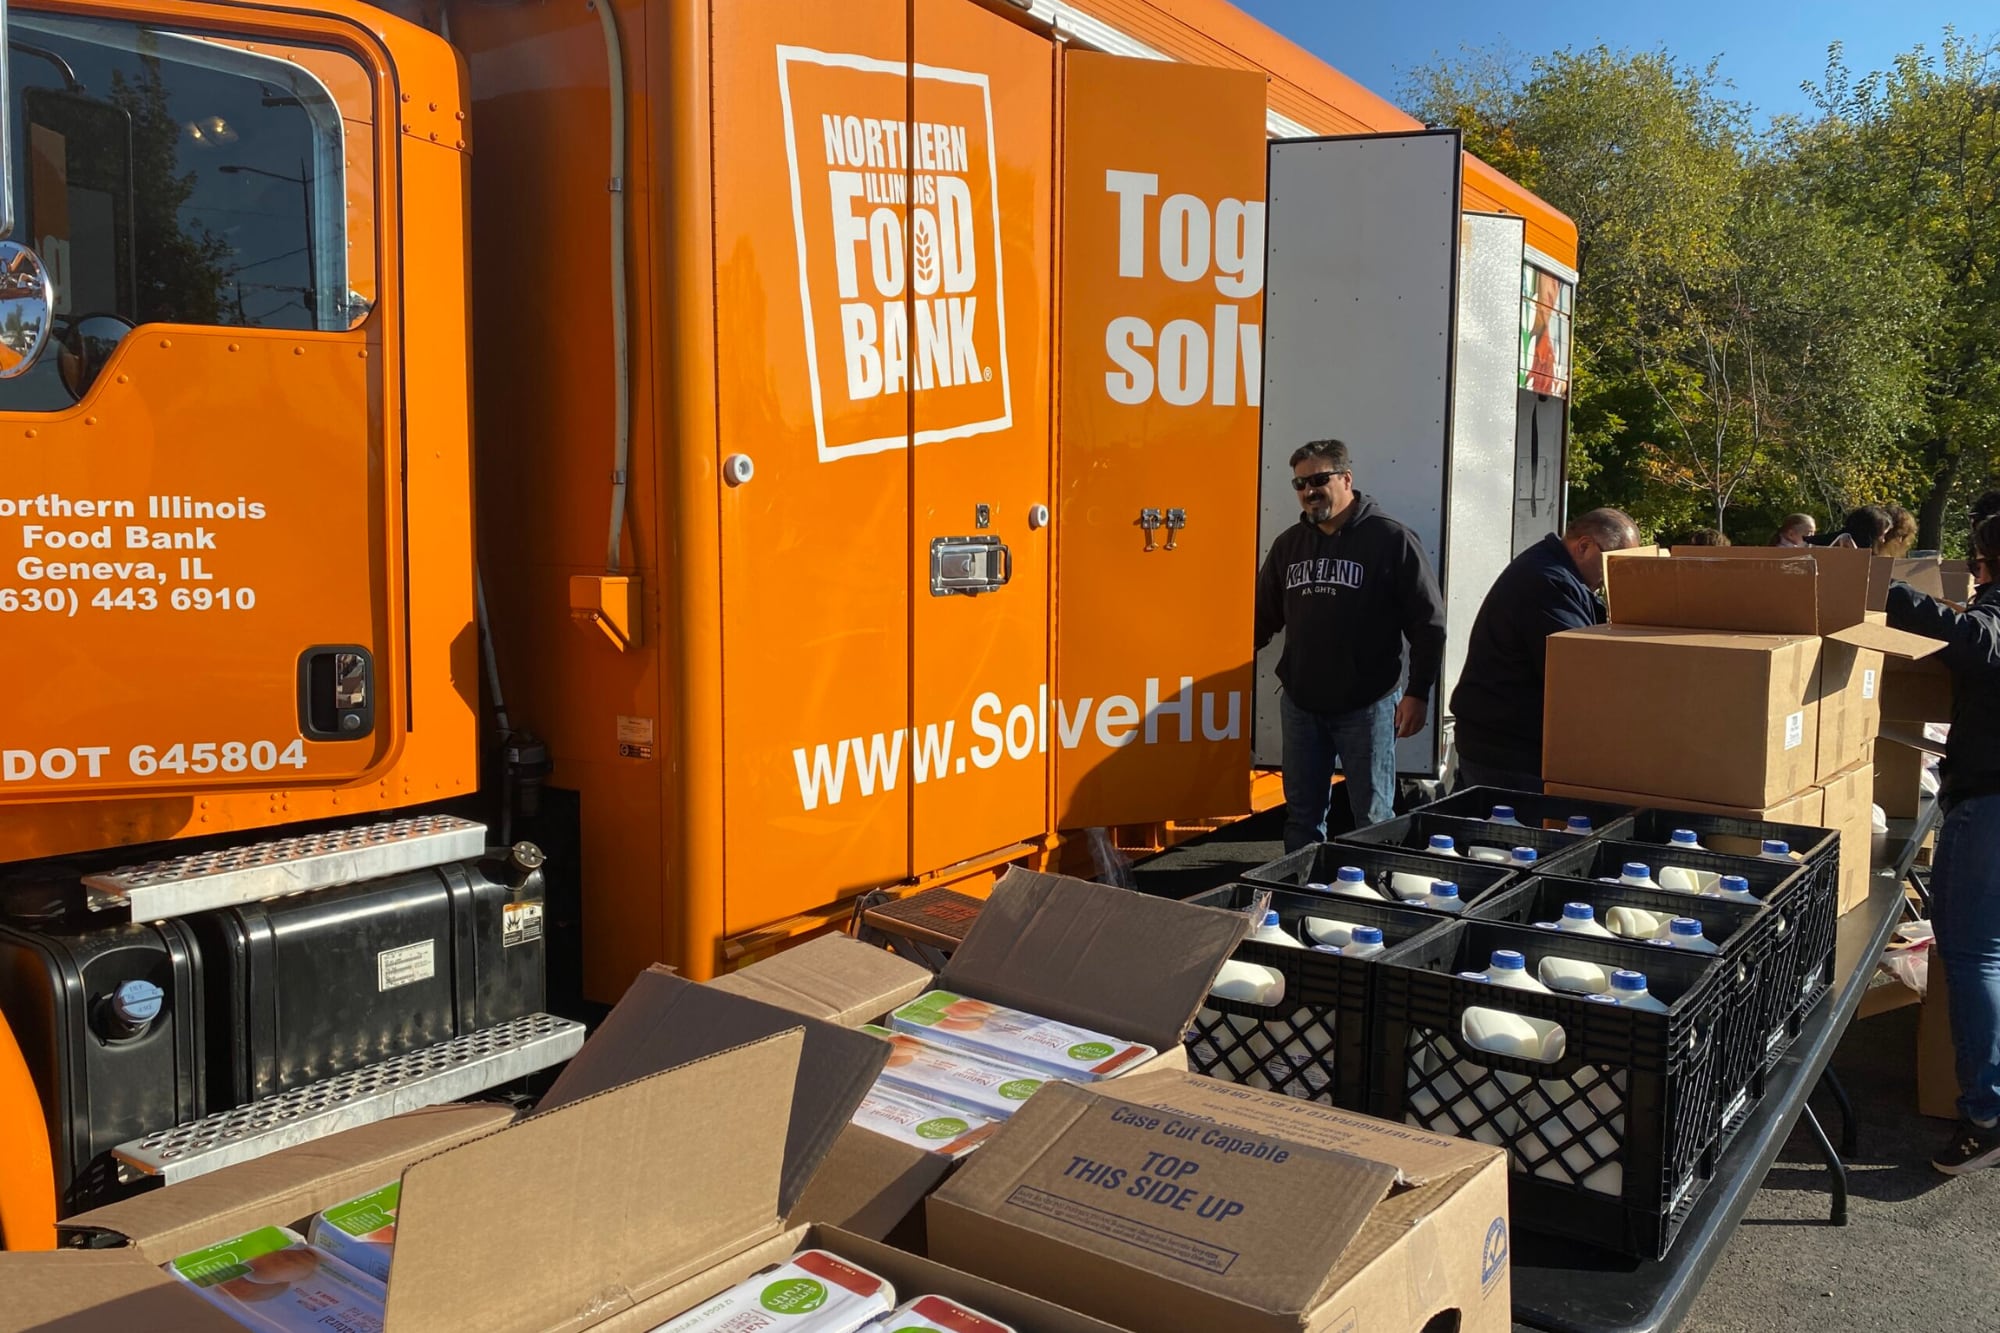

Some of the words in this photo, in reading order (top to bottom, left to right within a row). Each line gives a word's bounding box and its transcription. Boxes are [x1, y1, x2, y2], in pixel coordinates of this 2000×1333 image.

[822, 114, 969, 173] NORTHERN
[865, 172, 936, 205] ILLINOIS
[828, 171, 977, 299] FOOD
[1106, 169, 1265, 299] Tog
[148, 495, 267, 520] Illinois
[23, 525, 112, 549] Food
[125, 526, 217, 550] Bank
[17, 556, 167, 586] Geneva,
[180, 557, 213, 580] IL
[91, 587, 158, 611] 443
[171, 587, 256, 611] 6910
[3, 746, 111, 781] DOT
[128, 739, 307, 777] 645804
[1111, 1106, 1160, 1131] Case
[1163, 1120, 1200, 1142] Cut
[1201, 1130, 1290, 1165] Capable
[1141, 1152, 1200, 1181] TOP
[1063, 1156, 1128, 1190] THIS
[1126, 1176, 1199, 1211] SIDE
[1197, 1195, 1245, 1223] UP
[768, 1282, 809, 1307] truth
[781, 1287, 818, 1310] simple
